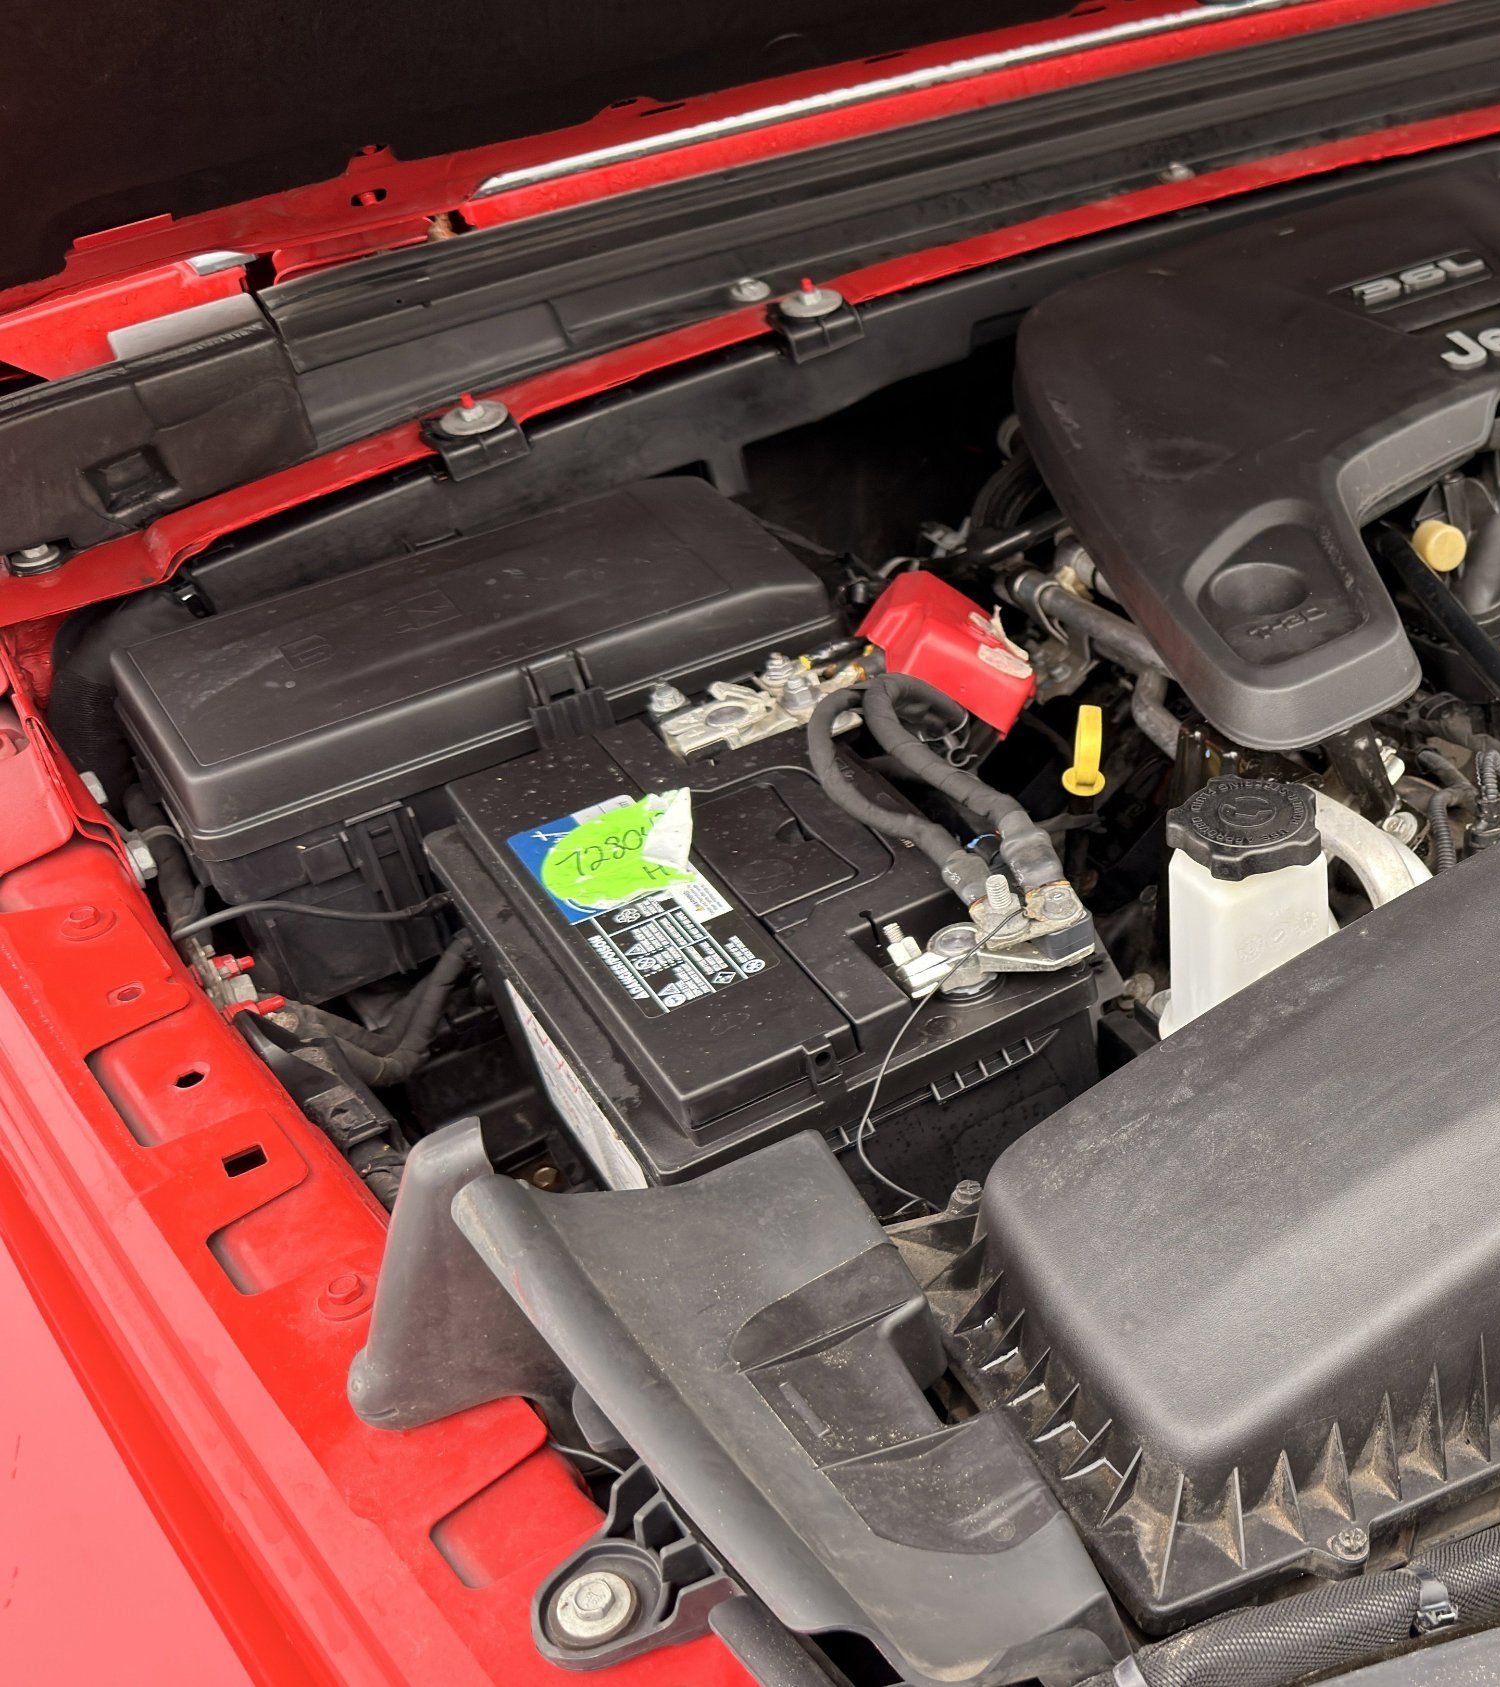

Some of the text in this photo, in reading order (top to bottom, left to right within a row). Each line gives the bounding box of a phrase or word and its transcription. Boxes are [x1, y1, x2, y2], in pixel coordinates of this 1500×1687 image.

[1191, 788, 1217, 813] FLUID
[1218, 778, 1289, 797] STEERING
[1191, 816, 1253, 845] APPROVED
[587, 934, 645, 995] DANGER/POISON
